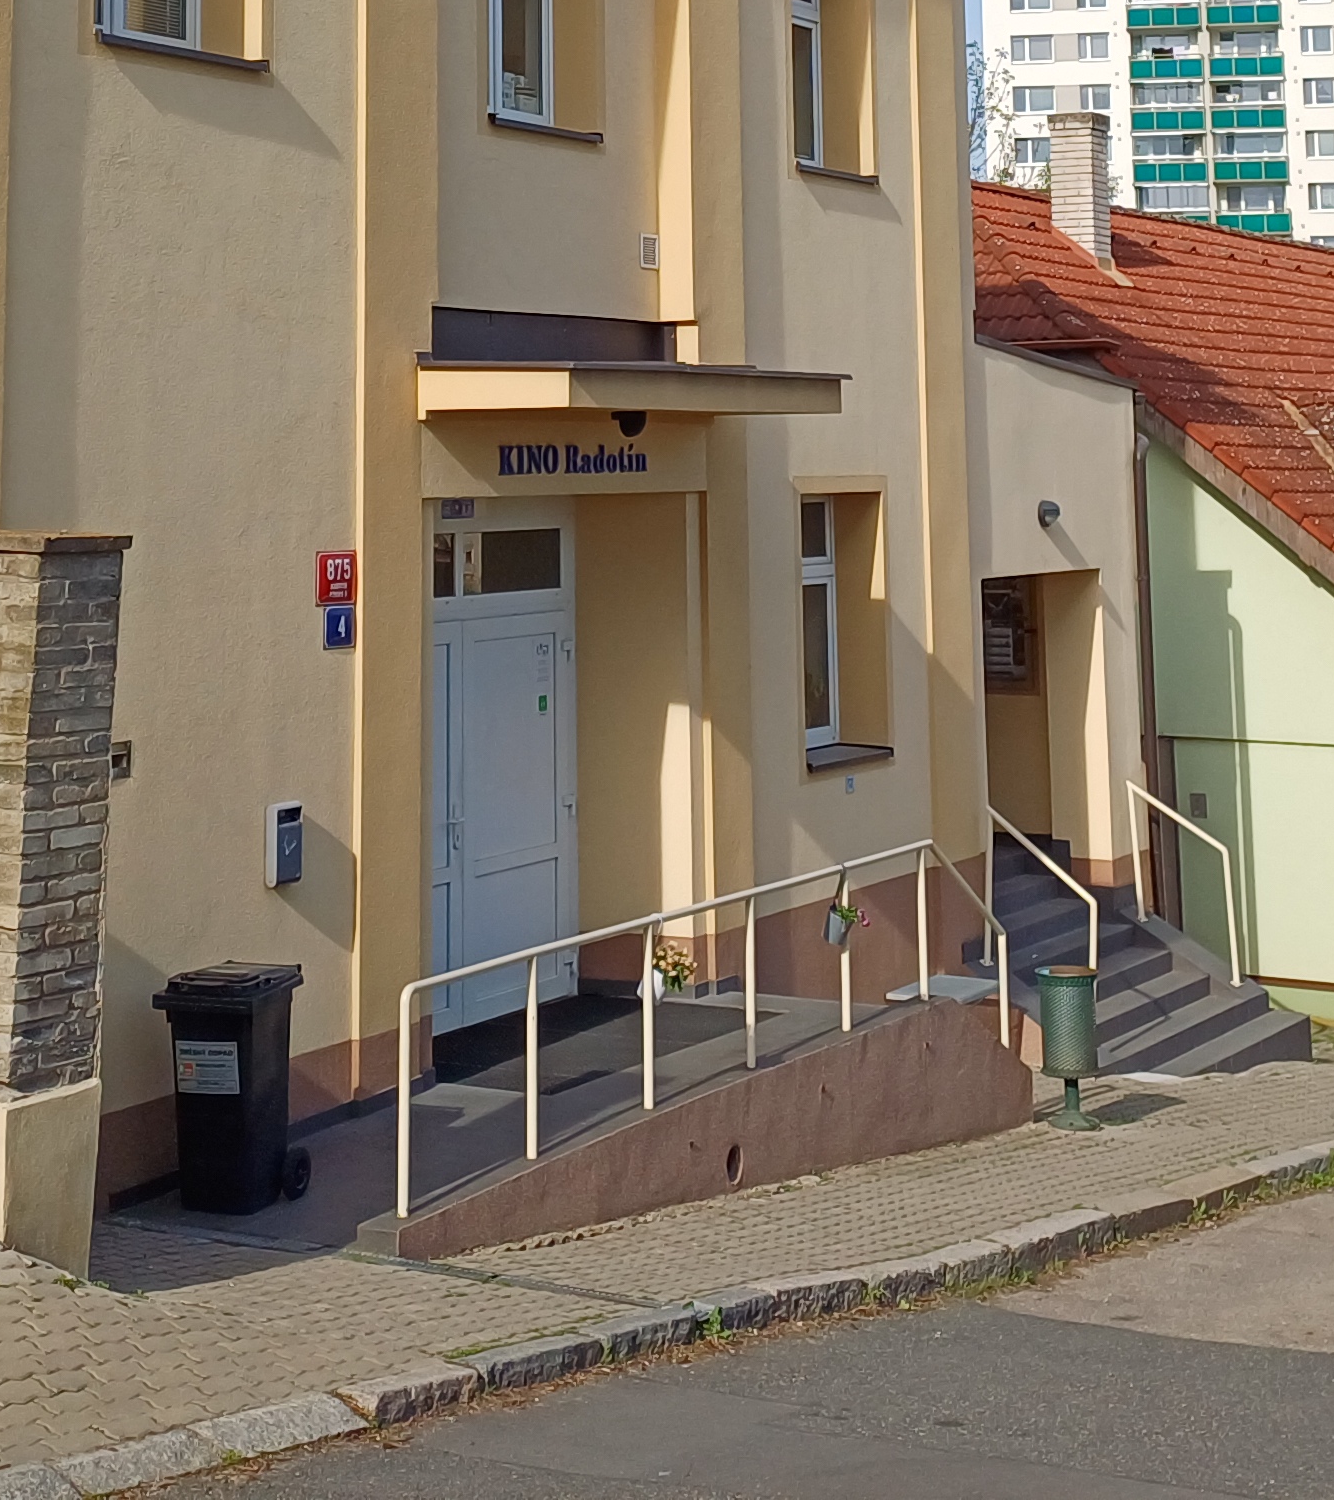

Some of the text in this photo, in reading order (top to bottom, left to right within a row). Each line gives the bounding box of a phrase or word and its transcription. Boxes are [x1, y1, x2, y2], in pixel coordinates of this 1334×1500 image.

[498, 443, 648, 476] KINO Radotín
[327, 558, 351, 581] 875
[337, 615, 346, 638] 4
